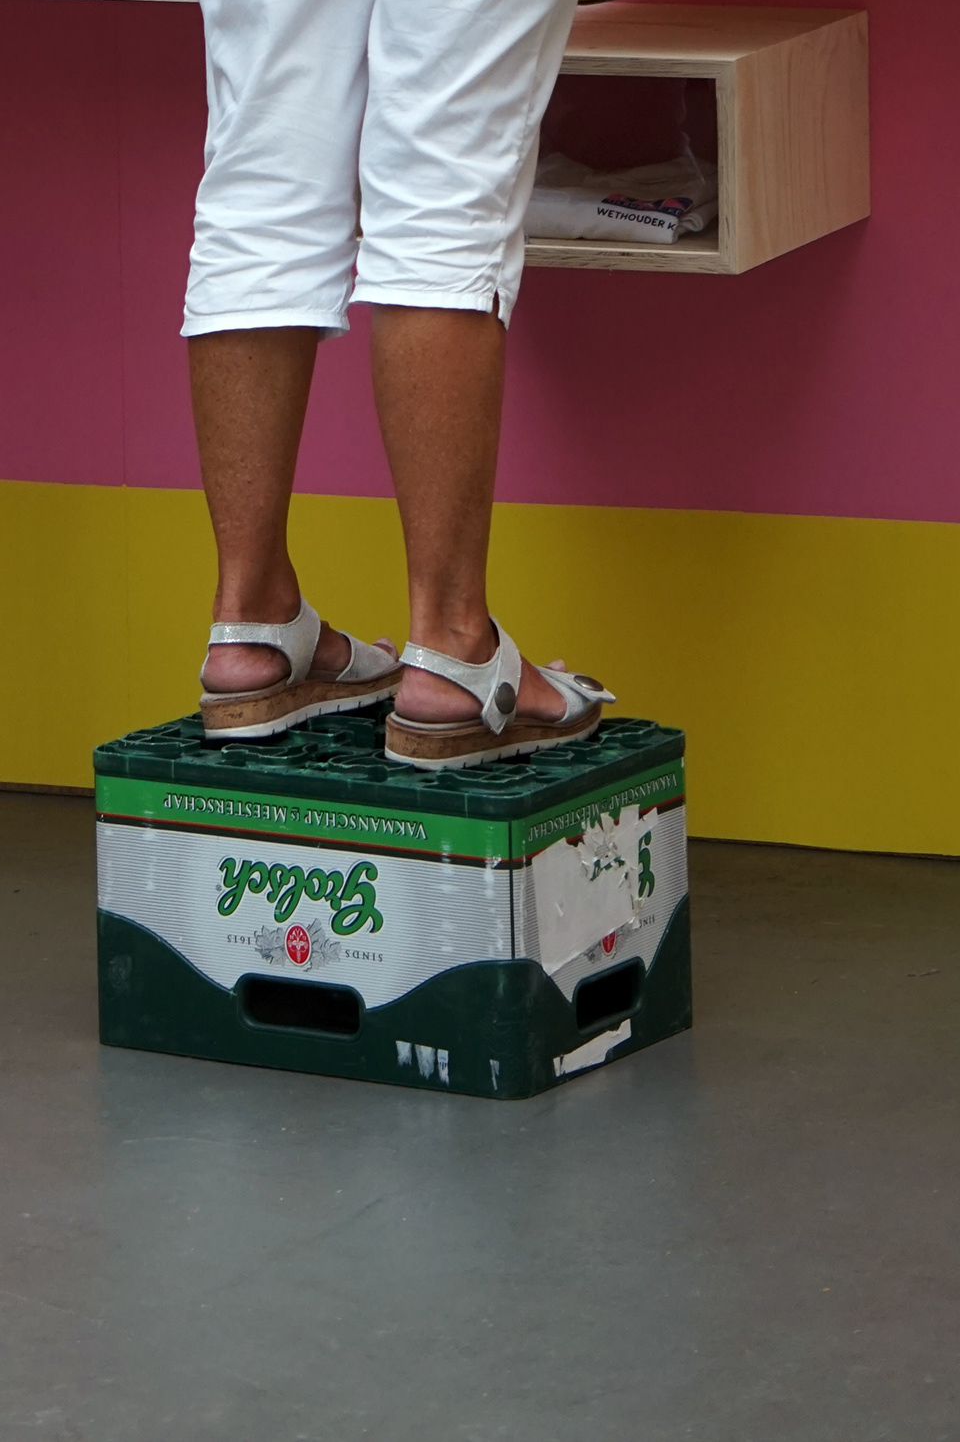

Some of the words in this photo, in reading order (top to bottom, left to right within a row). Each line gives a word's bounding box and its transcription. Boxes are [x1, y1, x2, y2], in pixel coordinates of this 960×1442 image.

[596, 206, 667, 229] WETHOUDER
[667, 221, 677, 232] K
[610, 772, 679, 811] VAKMANSCHAP
[163, 792, 288, 824] MEESTERSCHAP
[303, 809, 428, 841] VAKMANSCHAP
[217, 856, 385, 937] Grolsch
[226, 933, 253, 946] 1615
[344, 948, 384, 963] SINDS
